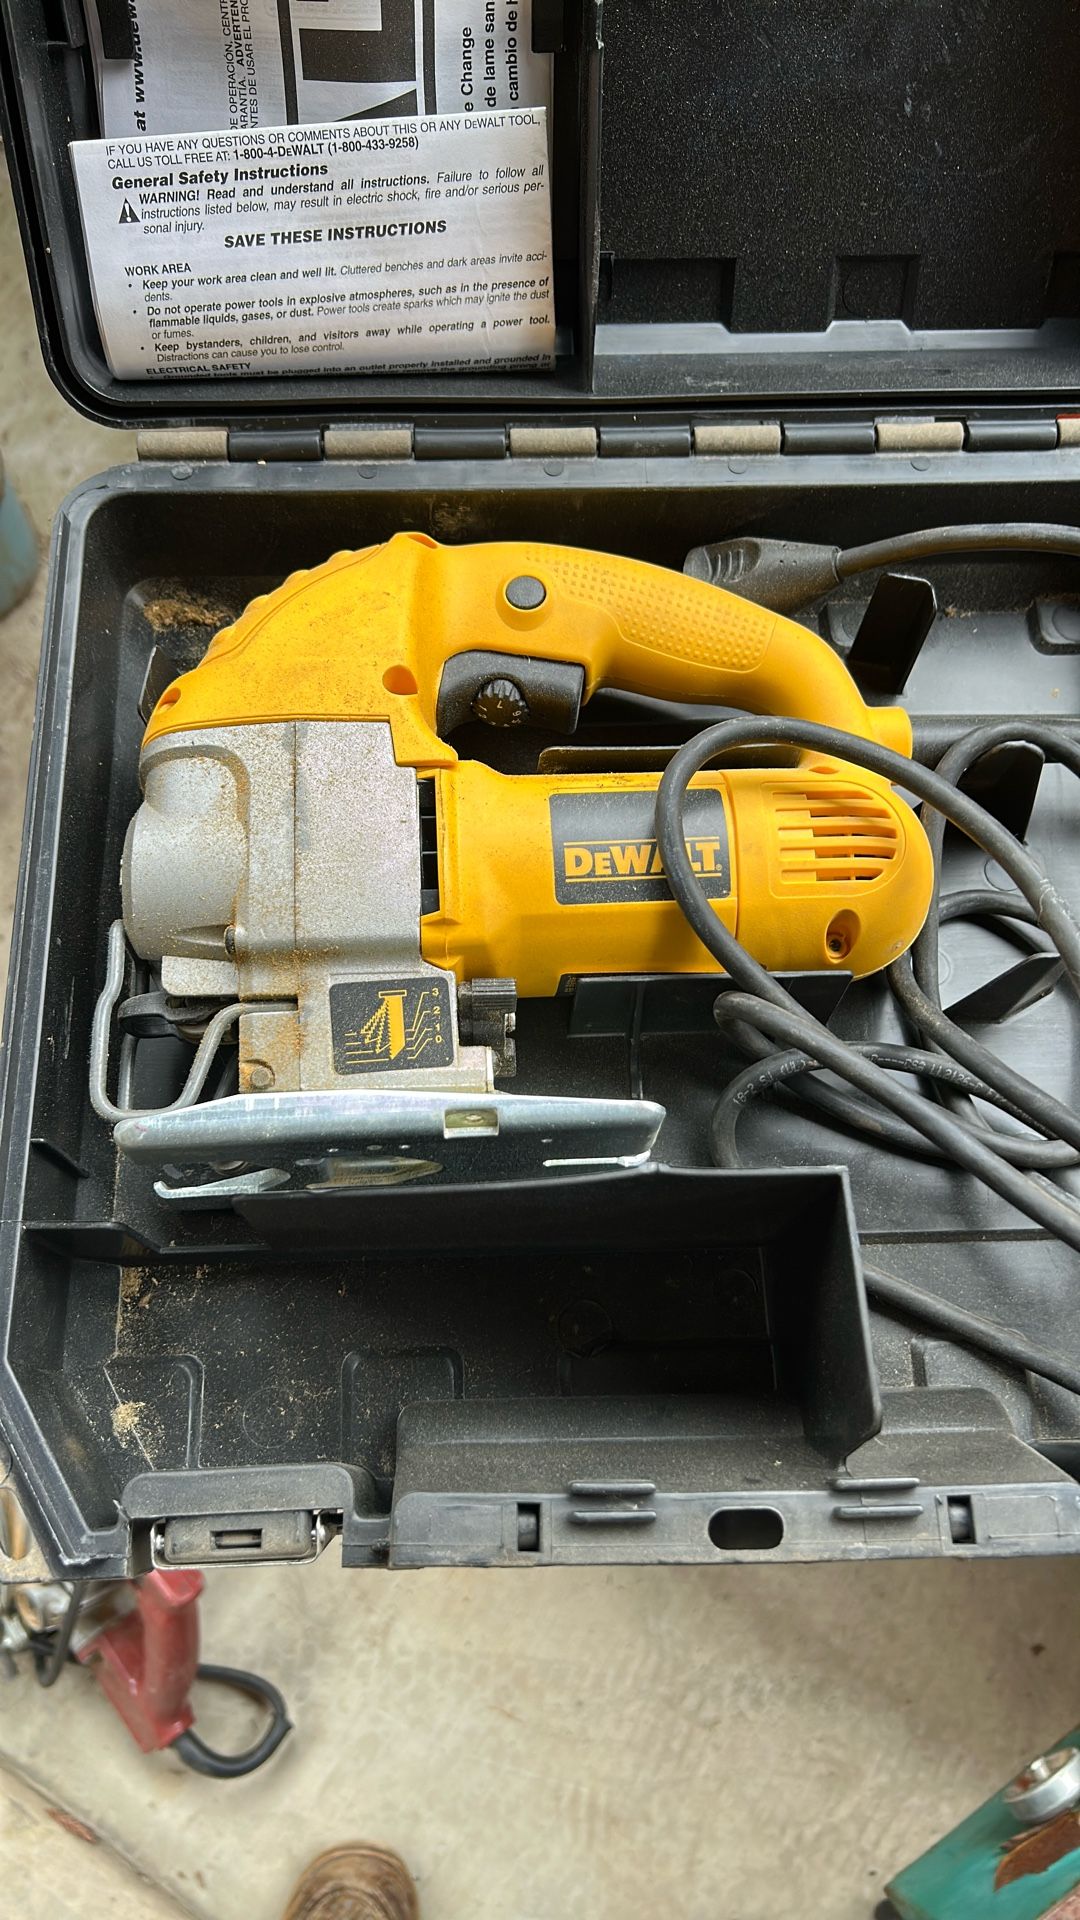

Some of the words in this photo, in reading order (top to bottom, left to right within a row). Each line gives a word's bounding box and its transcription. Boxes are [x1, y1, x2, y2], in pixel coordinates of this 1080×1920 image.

[244, 26, 252, 40] EL
[506, 11, 518, 32] de
[245, 44, 255, 76] USAR
[460, 26, 474, 96] Change
[483, 38, 495, 80] lame
[504, 38, 518, 101] cambio
[224, 41, 238, 114] OPERACIÓN,
[248, 79, 256, 96] DE
[484, 86, 496, 107] de
[134, 110, 146, 131] at
[105, 144, 115, 156] IF
[117, 142, 142, 155] YOU
[144, 140, 174, 153] HAVE
[176, 138, 198, 151] ANY
[201, 134, 265, 149] QUESTIONS
[268, 132, 285, 144] OR
[287, 127, 350, 143] COMMENTS
[353, 125, 389, 138] ABOUT
[392, 123, 417, 136] THIS
[420, 121, 436, 134] OR
[439, 120, 460, 132] ANY
[508, 114, 540, 127] TOOL,
[107, 157, 135, 169] CALL
[136, 155, 152, 167] US
[154, 153, 182, 166] TOLL
[184, 151, 213, 164] FREE
[215, 150, 230, 162] AT:
[327, 137, 418, 157] (1-800-433-9258)
[111, 173, 173, 189] General
[178, 170, 228, 185] Safety
[234, 165, 327, 182] Instructions
[138, 189, 199, 205] WARNING!
[206, 187, 235, 200] Read
[242, 185, 263, 197] and
[270, 180, 334, 195] understand
[340, 179, 353, 191] all
[360, 175, 429, 189] instructions.
[436, 171, 472, 184] Failure
[478, 169, 489, 181] to
[495, 167, 525, 180] follow
[531, 165, 543, 177] all
[141, 205, 200, 219] instructions
[204, 202, 232, 215] listed
[236, 200, 268, 212] below,
[273, 200, 296, 211] may
[300, 195, 328, 208] result
[332, 194, 342, 206] in
[346, 191, 383, 205] electric
[386, 189, 419, 202] shock,
[425, 188, 441, 199] fire
[445, 185, 479, 198] and/or
[482, 183, 519, 195] serious
[523, 183, 544, 195] per-
[143, 223, 171, 234] sonal
[174, 222, 204, 234] injury.
[224, 235, 265, 248] SAVE
[270, 231, 322, 245] THESE
[327, 222, 446, 241] INSTRUCTIONS
[124, 265, 158, 277] WORK
[161, 262, 191, 274] AREA
[142, 279, 168, 291] Keep
[171, 279, 194, 290] your
[197, 274, 222, 286] work
[225, 275, 246, 284] area
[250, 272, 276, 282] clean
[279, 269, 298, 280] and
[301, 267, 321, 279] well
[324, 266, 336, 277] lit.
[340, 263, 382, 276] Cluttered
[384, 261, 423, 273] benches
[426, 259, 444, 270] and
[447, 257, 467, 269] dark
[470, 257, 495, 267] areas
[499, 253, 522, 265] invite
[525, 252, 547, 263] acci-
[144, 292, 172, 303] dents.
[146, 306, 161, 317] Do
[164, 304, 181, 315] not
[183, 301, 221, 316] operate
[224, 301, 255, 313] power
[258, 297, 283, 308] tools
[286, 296, 296, 306] in
[299, 293, 345, 307] explosive
[349, 289, 414, 302] atmospheres,
[418, 285, 442, 297] such
[445, 286, 456, 295] as
[460, 283, 469, 293] in
[472, 282, 488, 293] the
[491, 280, 535, 293] presence
[538, 277, 549, 288] of
[149, 315, 200, 329] flammable
[202, 312, 238, 326] liquids,
[241, 312, 273, 324] gases,
[276, 310, 287, 319] or
[289, 307, 313, 318] dust.
[316, 306, 345, 316] Power
[348, 302, 370, 314] tools
[372, 300, 400, 312] create
[403, 298, 433, 311] sparks
[436, 295, 462, 307] which
[464, 296, 484, 306] may
[486, 292, 510, 305] ignite
[513, 291, 527, 302] the
[529, 289, 549, 300] dust
[151, 332, 161, 340] or
[163, 330, 193, 339] fumes.
[154, 343, 179, 353] Keep
[186, 339, 242, 352] bystanders,
[249, 335, 291, 346] children,
[298, 332, 316, 342] and
[323, 330, 358, 341] visitors
[365, 329, 390, 338] away
[397, 325, 422, 335] while
[428, 321, 474, 335] operating
[492, 319, 522, 330] power
[529, 316, 549, 326] tool.
[156, 351, 209, 363] Distractions
[211, 351, 228, 360] can
[230, 349, 258, 358] cause
[260, 348, 277, 358] you
[279, 346, 288, 355] to
[290, 345, 309, 354] lose
[311, 342, 344, 353] control.
[145, 364, 210, 375] ELECTRICAL
[211, 362, 250, 372] SAFETY
[432, 988, 439, 997] 3
[433, 1006, 440, 1014] 2
[435, 1023, 440, 1031] 1
